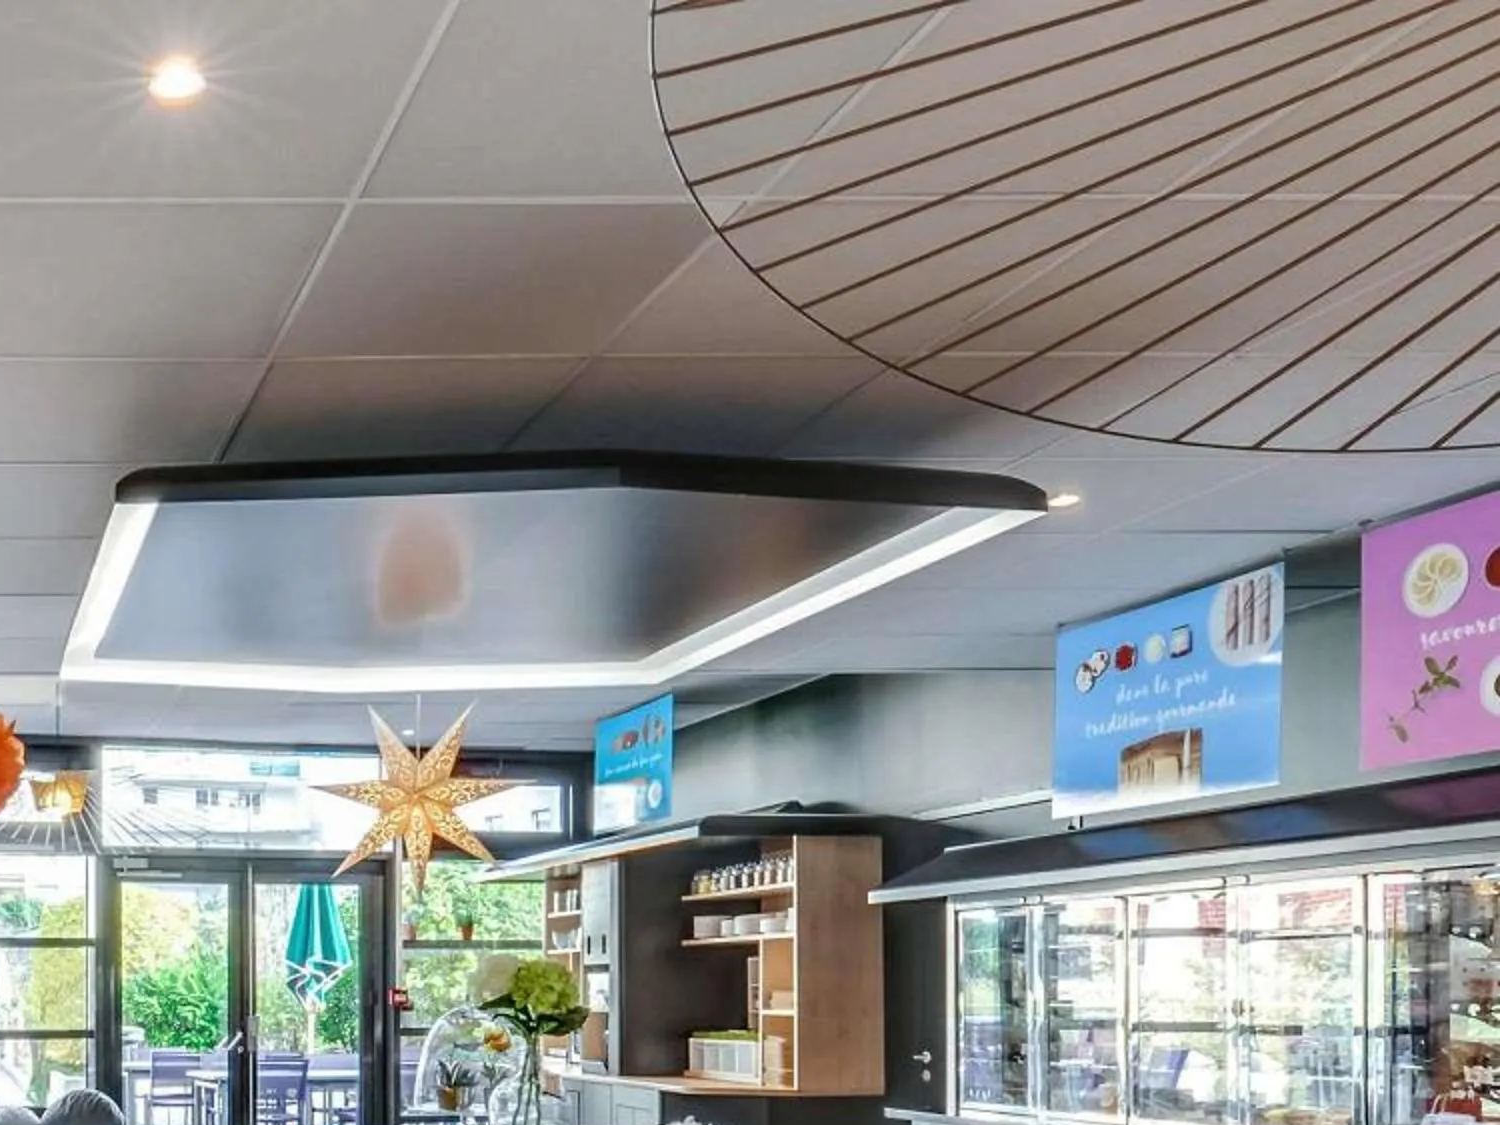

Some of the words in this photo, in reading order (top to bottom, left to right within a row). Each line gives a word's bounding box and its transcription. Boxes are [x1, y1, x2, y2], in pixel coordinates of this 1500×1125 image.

[1154, 673, 1171, 694] la
[1085, 710, 1150, 738] tradition
[1155, 687, 1236, 732] gourmande
